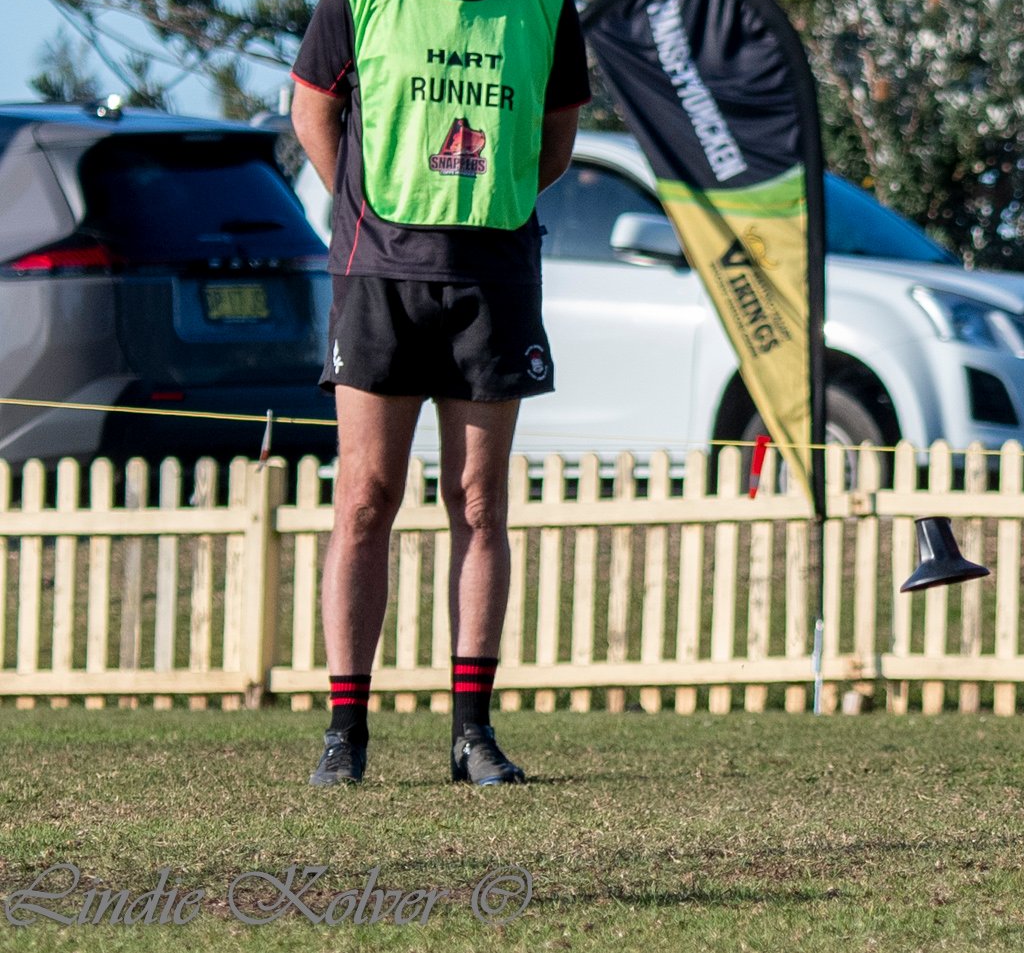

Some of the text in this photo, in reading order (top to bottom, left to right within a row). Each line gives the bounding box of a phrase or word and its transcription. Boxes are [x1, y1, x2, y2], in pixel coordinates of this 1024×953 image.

[426, 48, 504, 69] HART
[411, 77, 515, 111] RUNNER
[720, 238, 780, 353] VIKINGS
